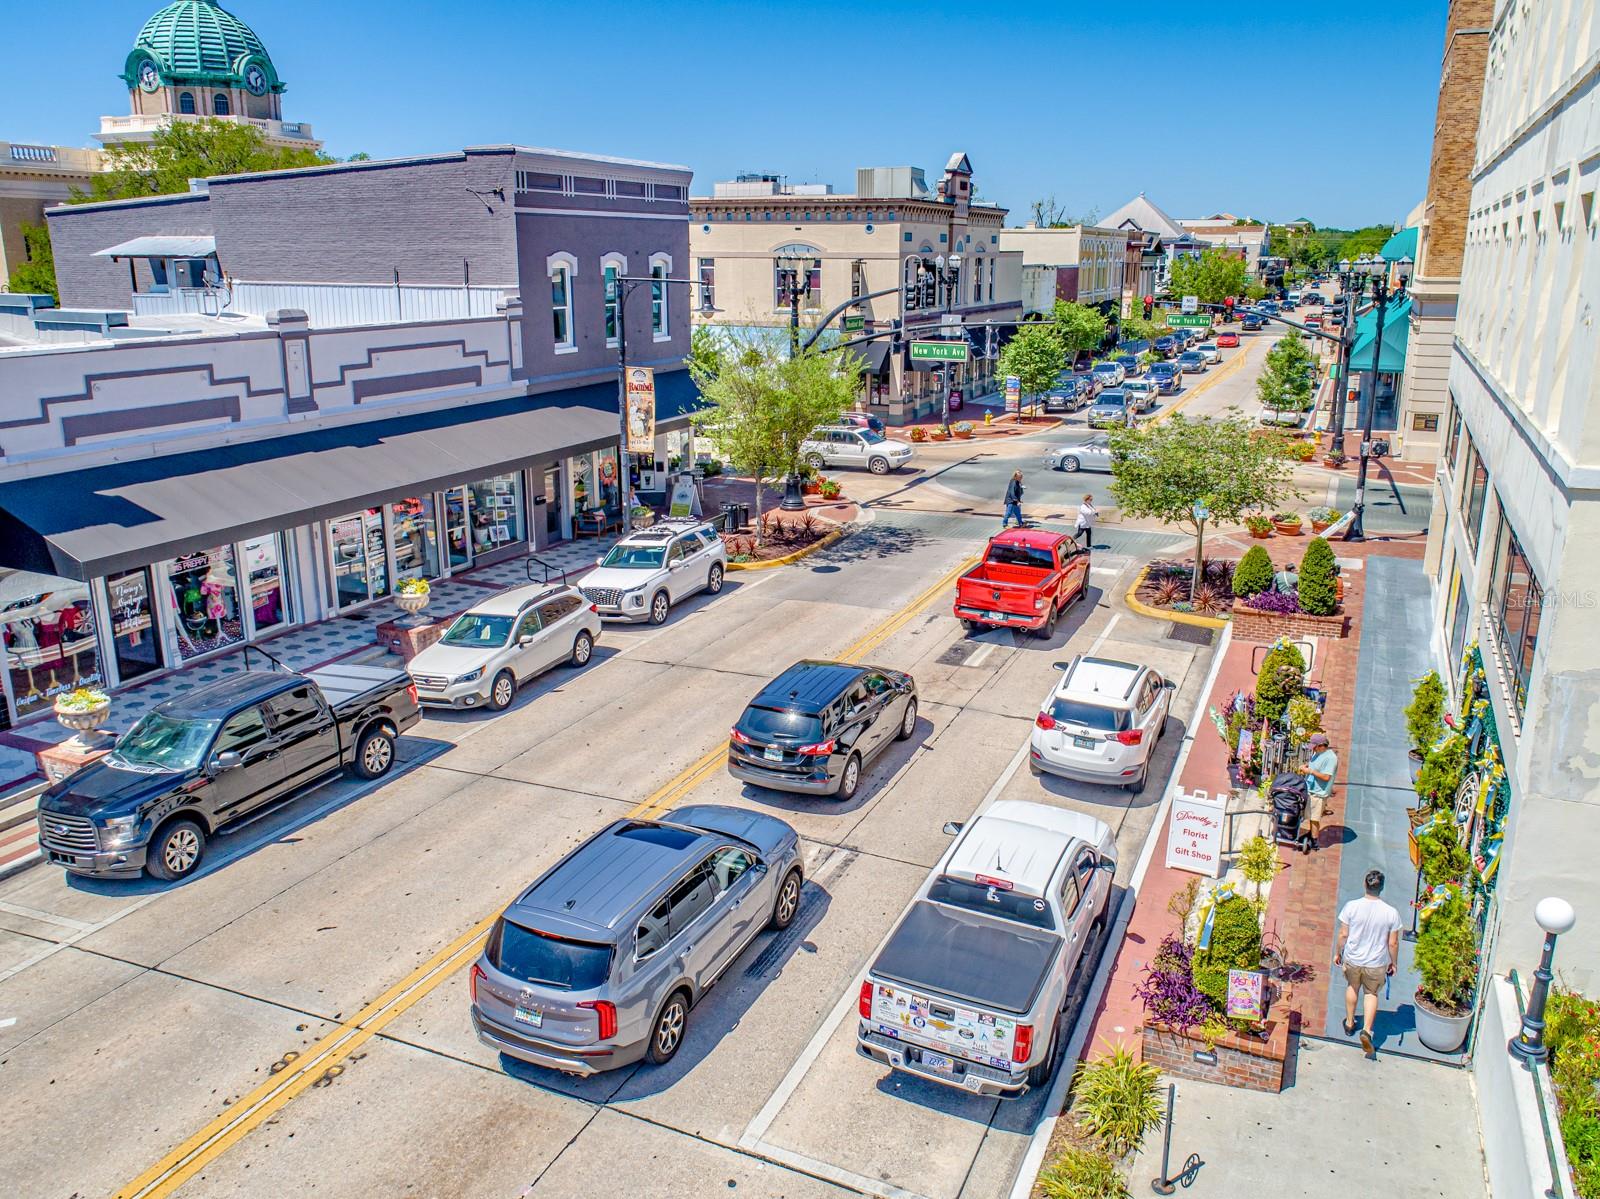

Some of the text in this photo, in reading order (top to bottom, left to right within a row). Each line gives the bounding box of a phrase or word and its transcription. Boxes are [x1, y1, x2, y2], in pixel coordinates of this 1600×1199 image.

[1168, 316, 1180, 324] New
[913, 346, 965, 357] New York Ave
[1175, 810, 1219, 829] Dorothy's
[1182, 828, 1209, 840] Florist
[1191, 840, 1198, 848] &
[1175, 847, 1212, 861] Gift Shop
